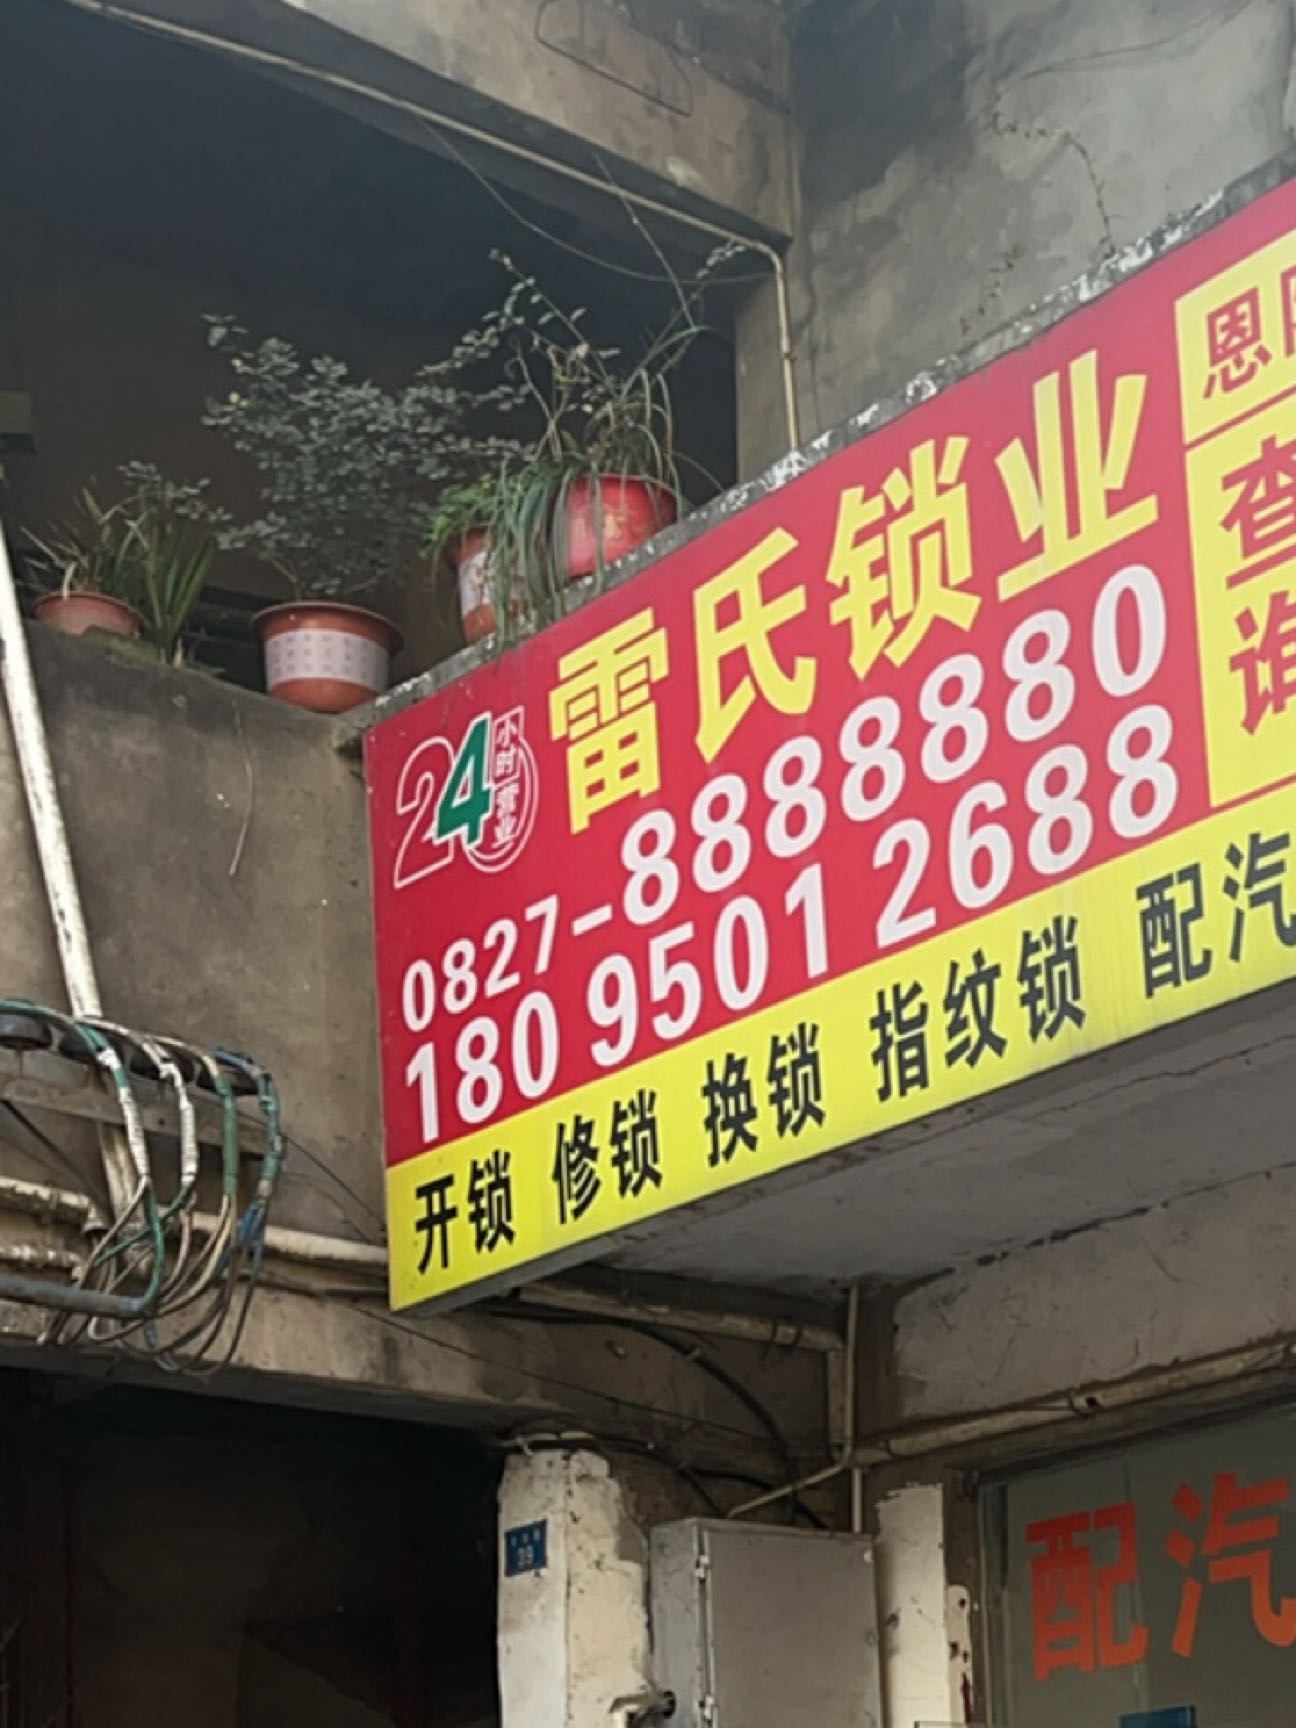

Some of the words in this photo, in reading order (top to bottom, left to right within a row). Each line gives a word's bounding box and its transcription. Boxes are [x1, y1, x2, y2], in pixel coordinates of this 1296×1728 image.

[394, 711, 494, 890] 24
[402, 563, 1167, 1033] 0827-8888880
[549, 349, 1159, 834] 雷氏锁业
[405, 990, 559, 1144] 180
[587, 863, 829, 1067] 9501
[871, 703, 1179, 950] 2688
[415, 1150, 516, 1275] 开锁
[551, 1089, 663, 1225] 修锁
[701, 1022, 827, 1168] 换锁
[869, 914, 1087, 1102] 指纹锁
